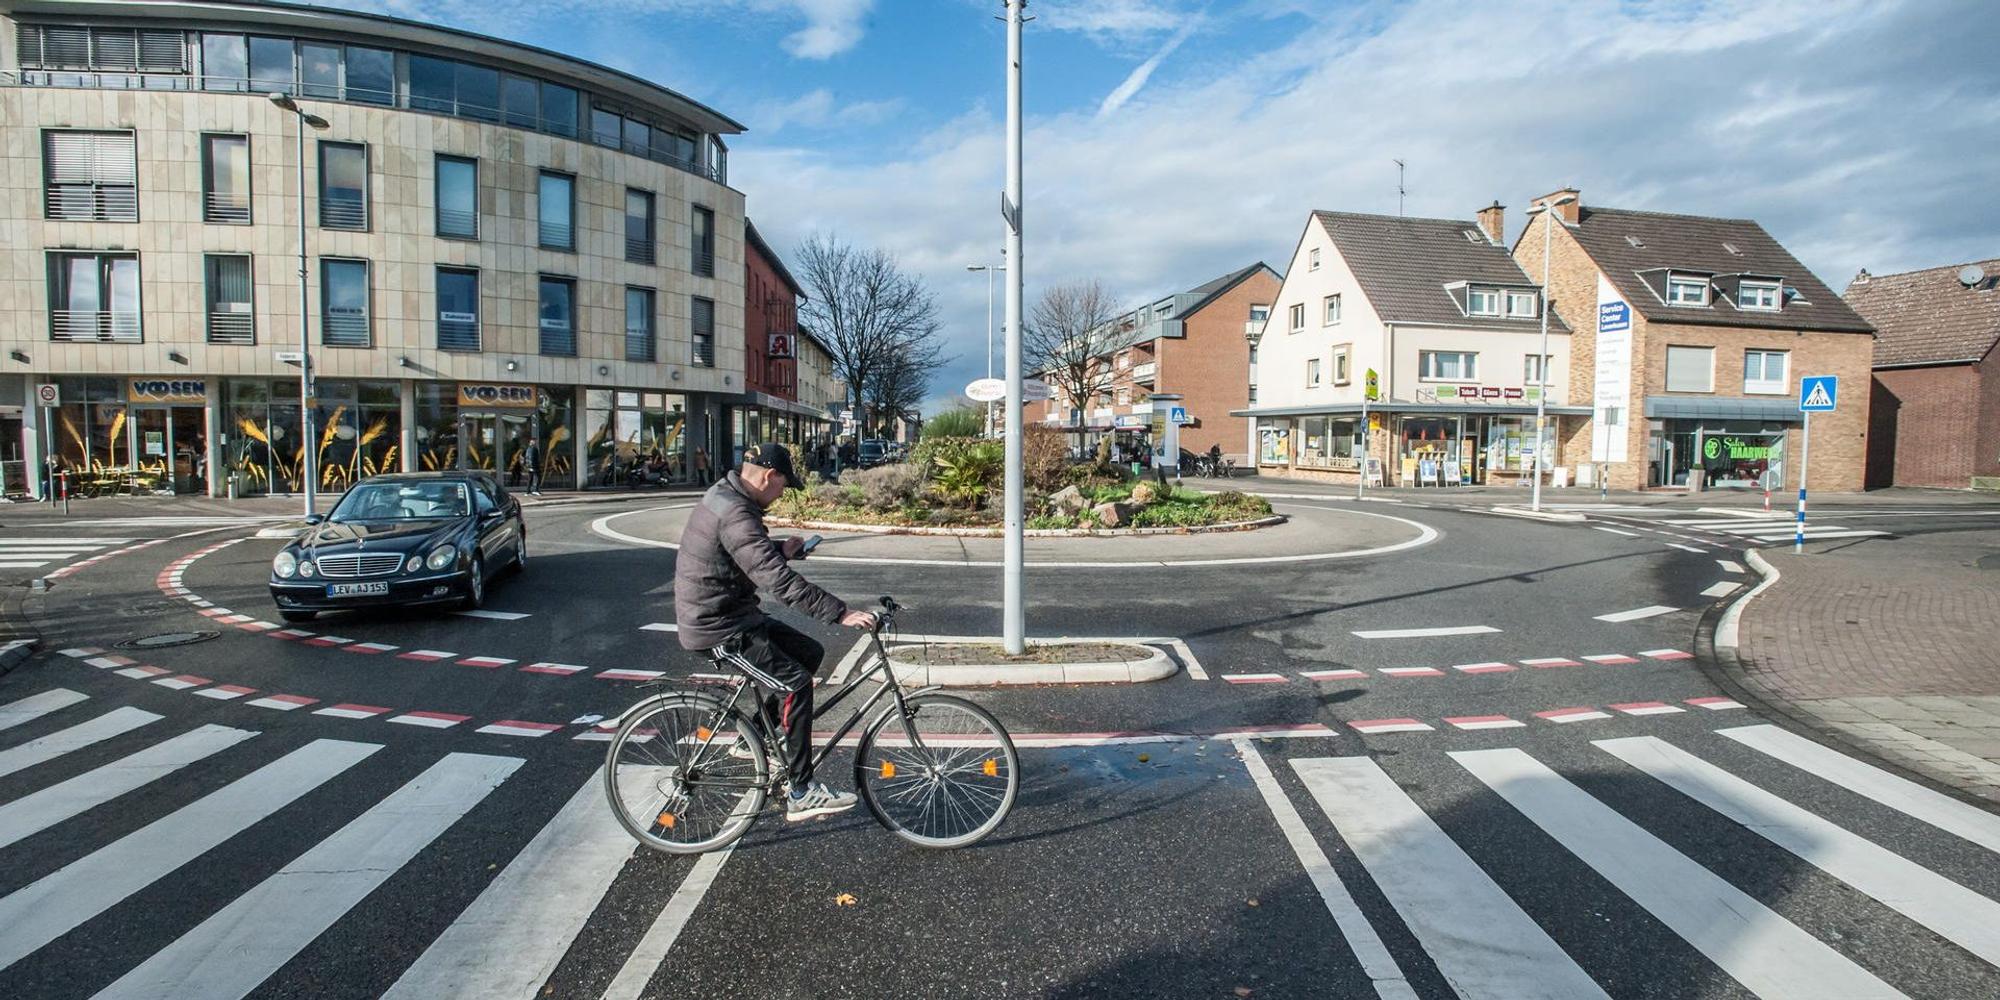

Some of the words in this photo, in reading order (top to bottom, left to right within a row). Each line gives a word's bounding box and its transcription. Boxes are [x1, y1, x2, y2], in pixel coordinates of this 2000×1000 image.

[1601, 304, 1624, 313] Service
[1601, 313, 1622, 322] Center
[133, 381, 205, 397] VOOSEN
[463, 386, 532, 400] VOOSEN
[1730, 446, 1779, 459] HAARWE
[333, 585, 350, 594] LEV
[357, 584, 368, 593] AJ
[370, 583, 387, 592] 153
